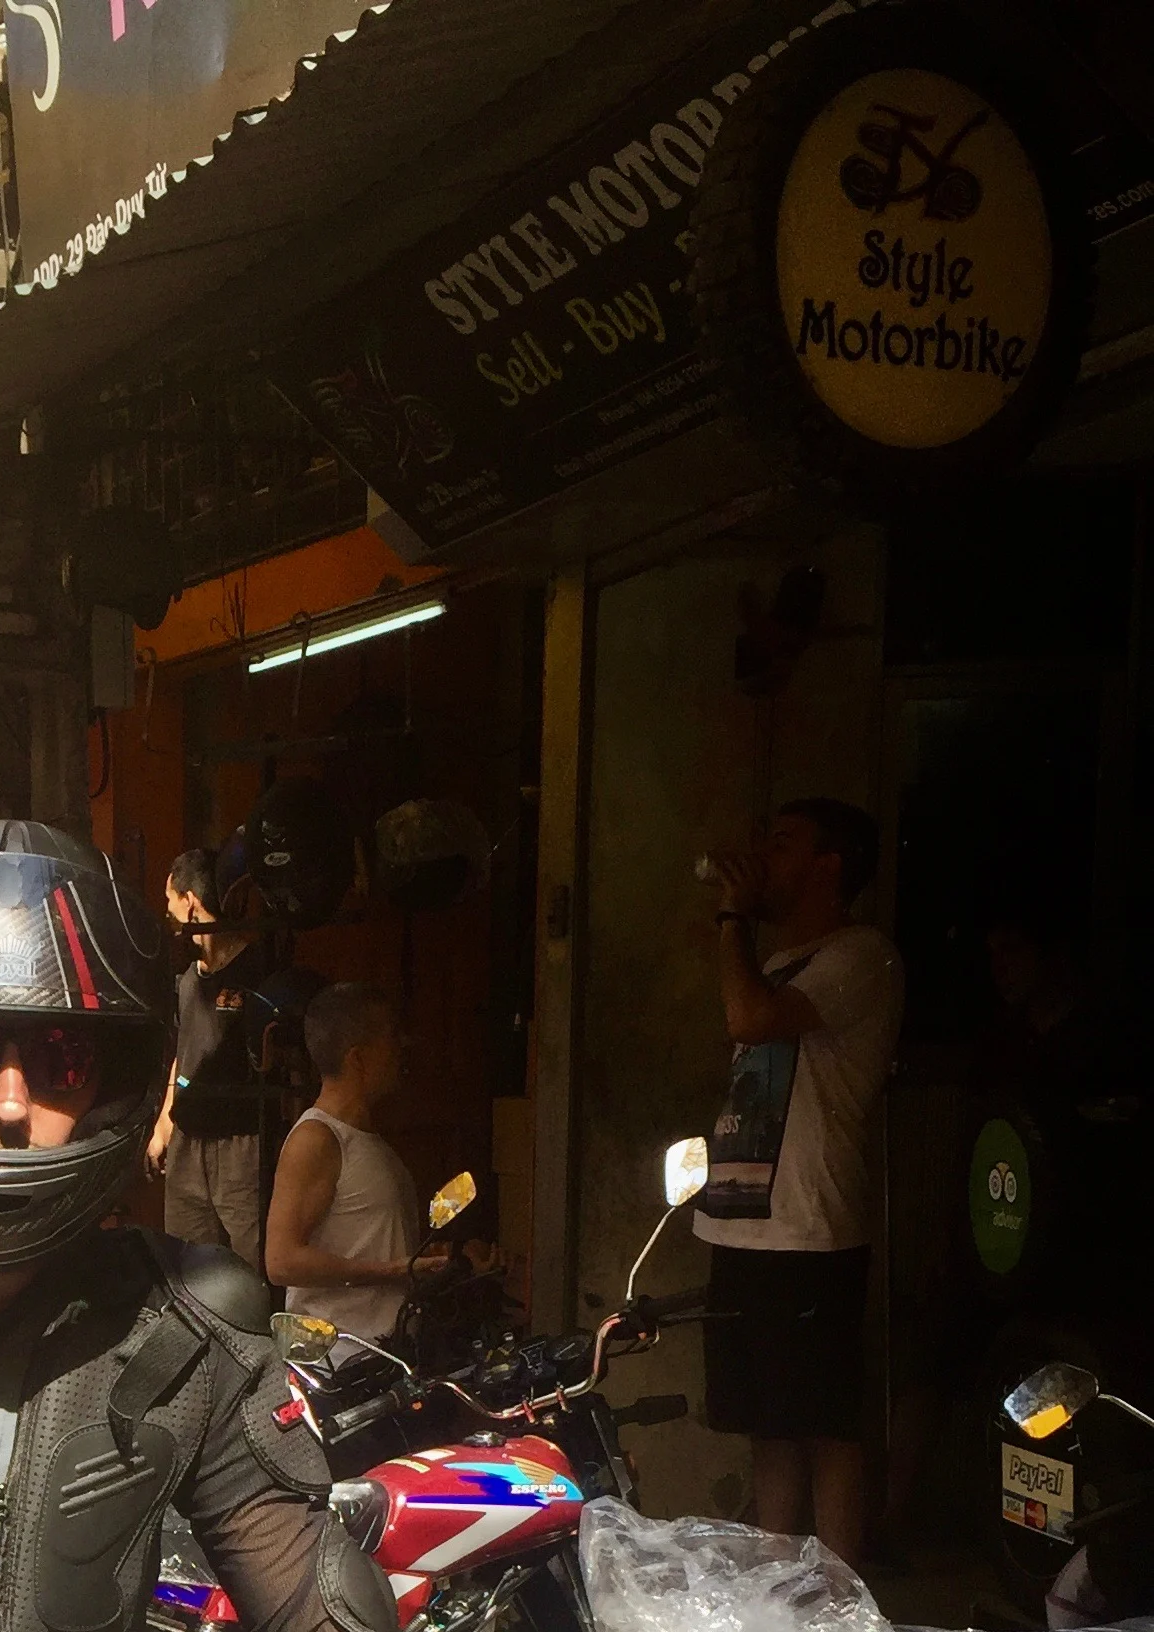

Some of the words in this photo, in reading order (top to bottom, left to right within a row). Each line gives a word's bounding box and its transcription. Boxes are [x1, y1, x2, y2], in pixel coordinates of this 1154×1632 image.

[66, 233, 84, 271] 29
[424, 212, 578, 335] STYLE
[858, 229, 974, 308] Style
[476, 330, 563, 407] Sell
[565, 281, 666, 355] Buy
[797, 298, 1027, 382] Motorbike
[511, 1484, 568, 1495] ESPERO
[1010, 1454, 1064, 1496] PayPal
